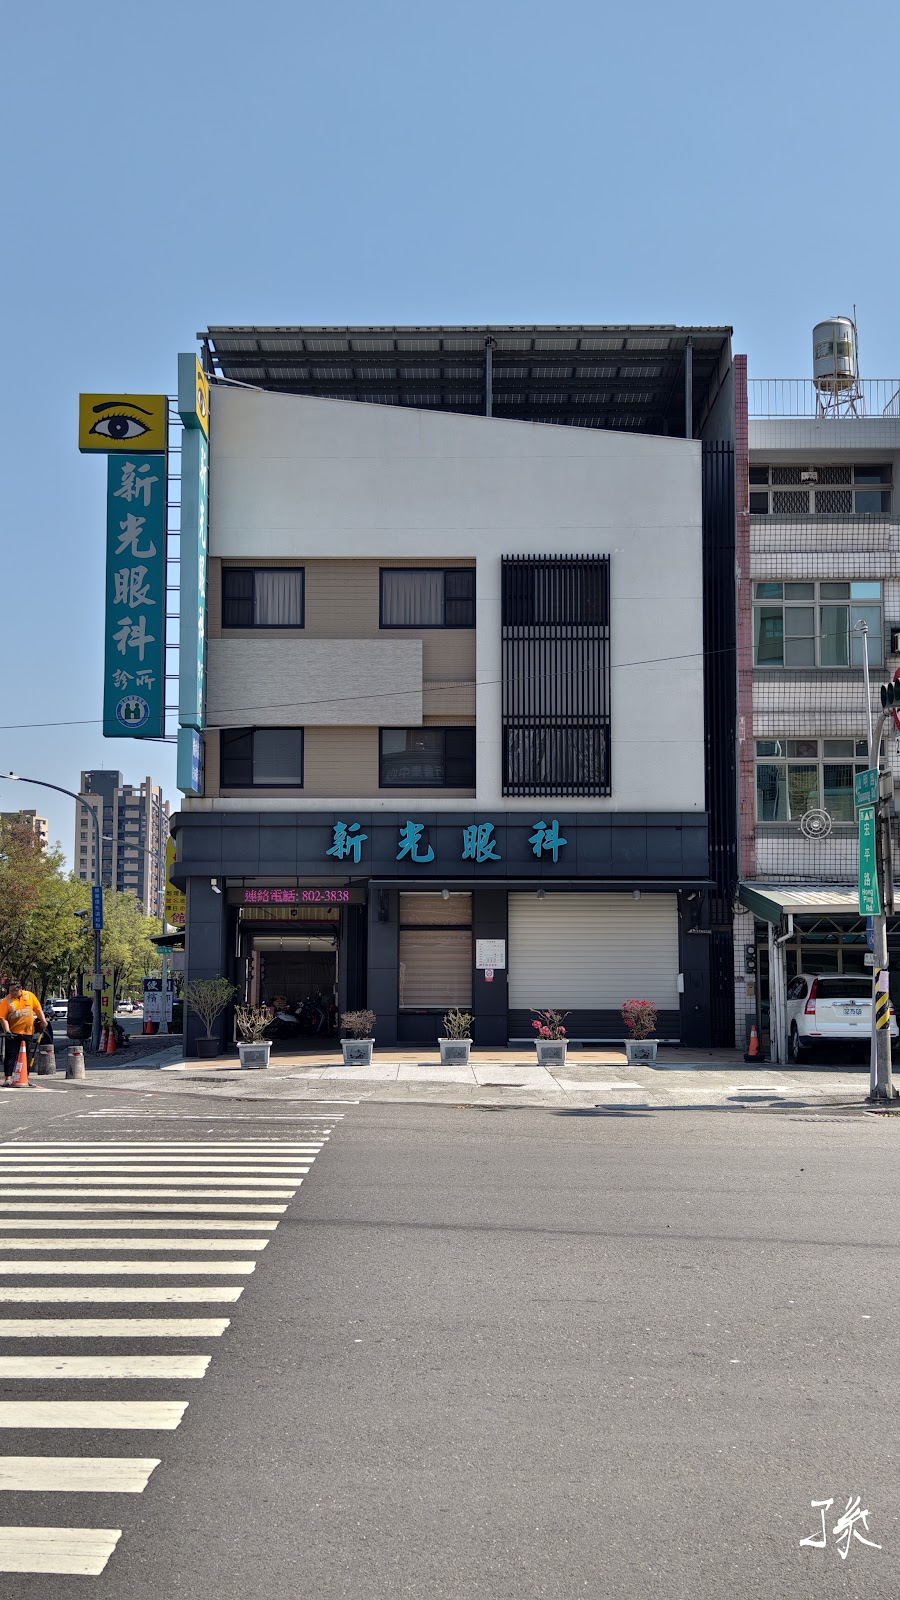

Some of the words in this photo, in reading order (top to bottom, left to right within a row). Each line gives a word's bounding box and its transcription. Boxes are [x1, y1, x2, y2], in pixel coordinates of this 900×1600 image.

[111, 461, 160, 662] 新光眼科
[111, 668, 156, 691] 診所
[326, 819, 568, 863] 新光眼科
[863, 822, 871, 886] 宏平路
[302, 890, 350, 901] 802-3838
